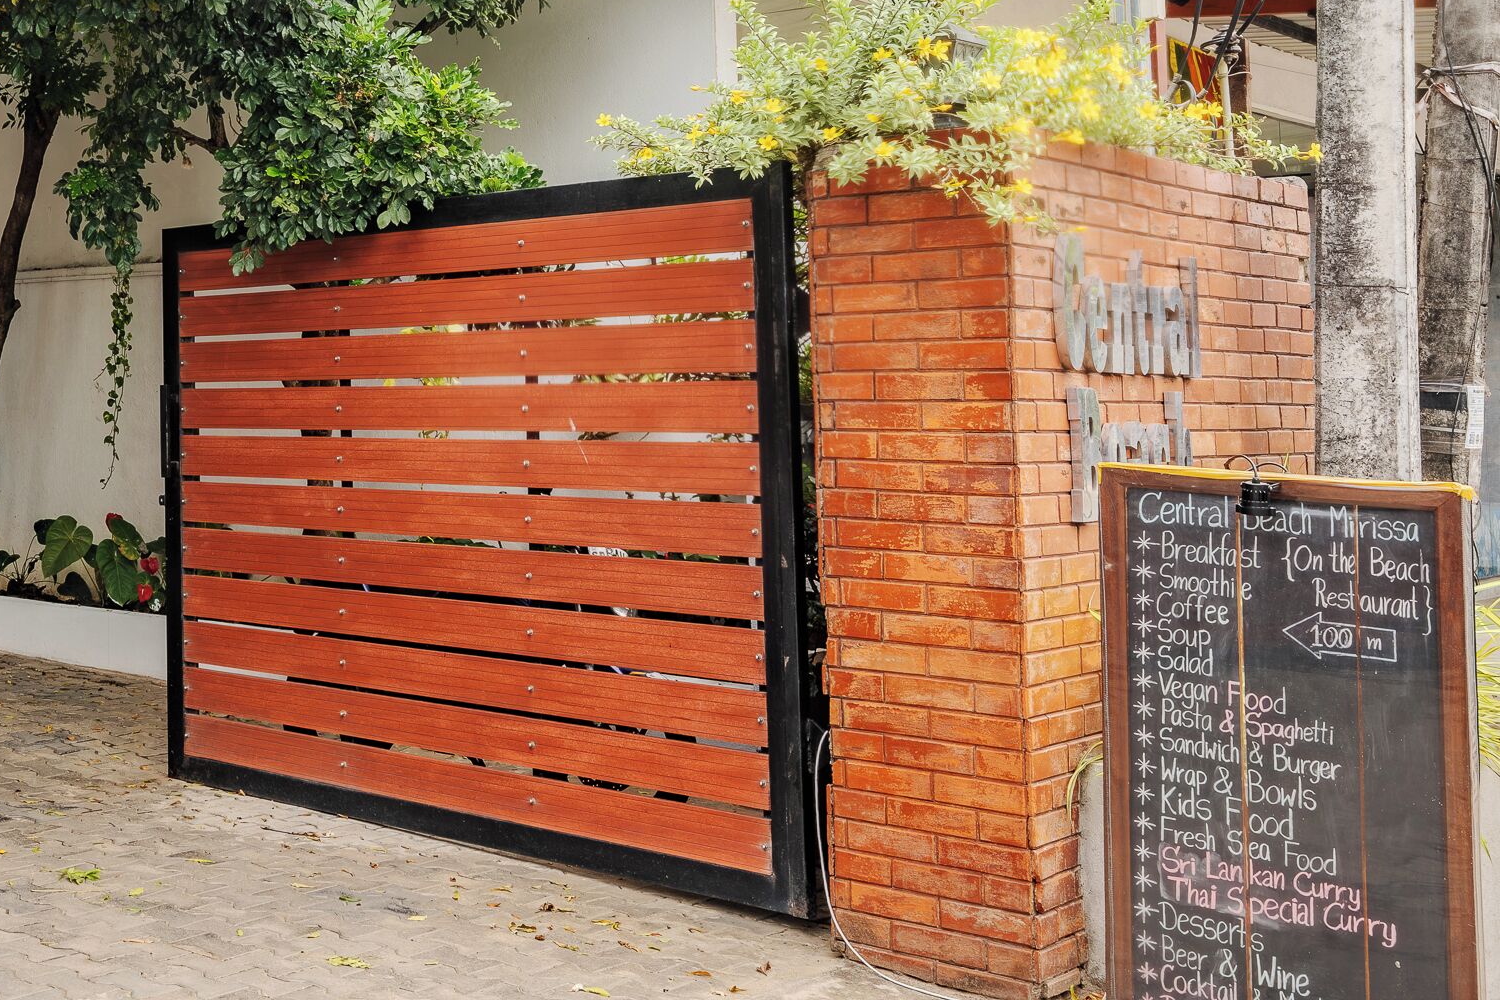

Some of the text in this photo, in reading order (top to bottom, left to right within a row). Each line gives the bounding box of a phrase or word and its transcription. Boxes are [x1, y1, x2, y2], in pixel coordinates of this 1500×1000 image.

[1052, 232, 1201, 378] Central
[1138, 491, 1229, 528] Central
[1330, 505, 1419, 542] Mirissa
[1161, 530, 1262, 569] Breakfast
[1328, 541, 1356, 574] the
[1370, 546, 1430, 583] Beach
[1159, 563, 1252, 600] Smoothie
[1156, 591, 1229, 625] Coffee
[1157, 618, 1211, 657] Soup
[1157, 645, 1214, 677] Salad
[1310, 624, 1382, 651] 100 m
[1158, 671, 1287, 715] Vegan Food
[1161, 698, 1334, 747] Pasta & Spaghetti
[1159, 727, 1342, 784] Sandwich & Burger
[1161, 755, 1317, 811] Wrap & Bowls
[1161, 784, 1294, 840] Kids Food
[1160, 816, 1337, 876] Fresh Sea Food
[1161, 846, 1361, 911] Sri Lankan Curry
[1158, 902, 1264, 952] Desserts
[1167, 876, 1397, 948] Thai Special Curry
[1160, 964, 1237, 1000] Cocktail
[1161, 934, 1311, 997] Beer & Wine
